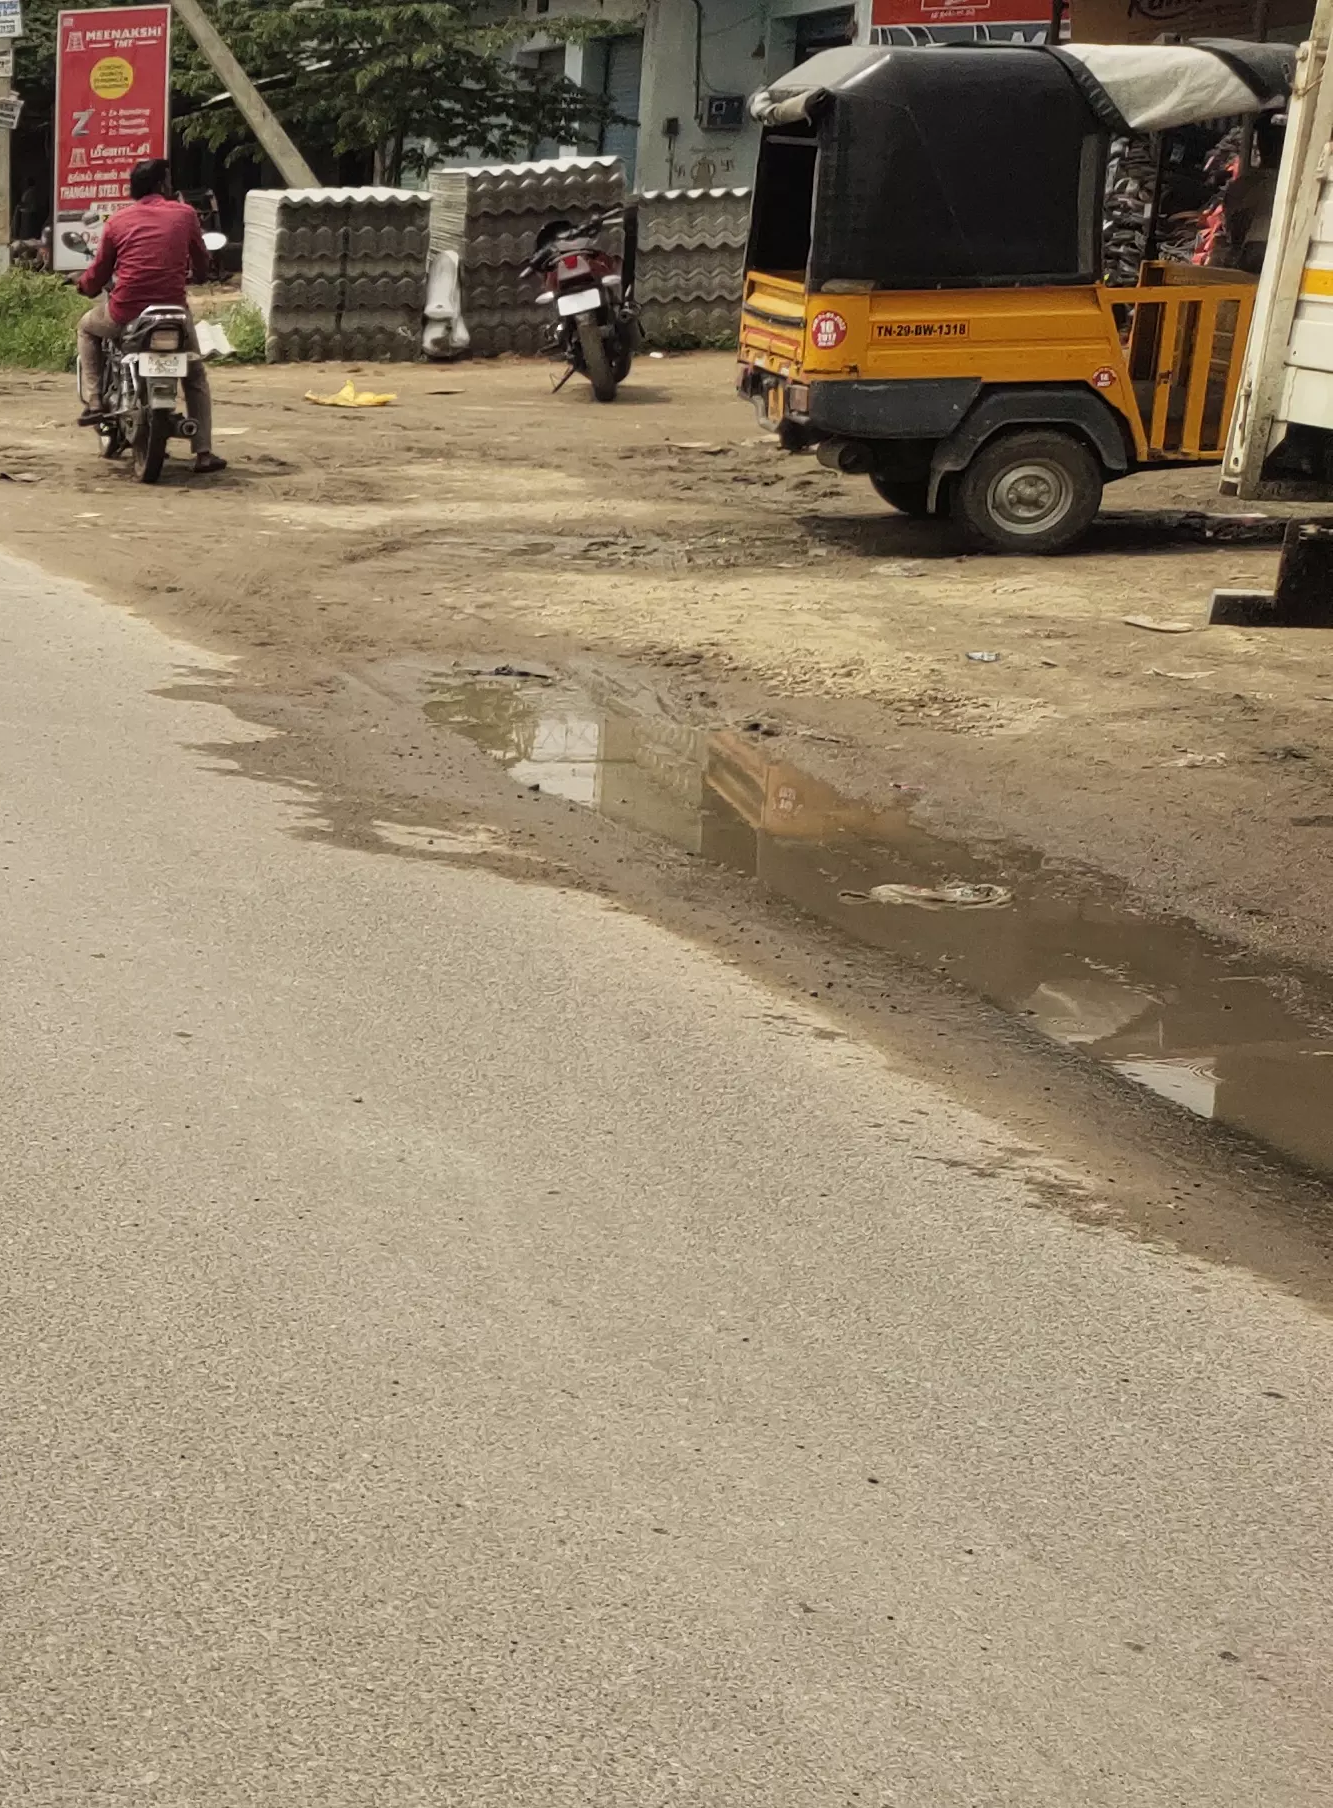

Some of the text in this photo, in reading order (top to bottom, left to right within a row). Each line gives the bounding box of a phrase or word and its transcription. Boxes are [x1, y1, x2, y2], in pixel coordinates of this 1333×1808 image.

[85, 26, 162, 41] MEENAKSHI
[113, 39, 134, 48] TMT
[60, 186, 97, 199] THANGAM
[98, 184, 119, 198] STEEL
